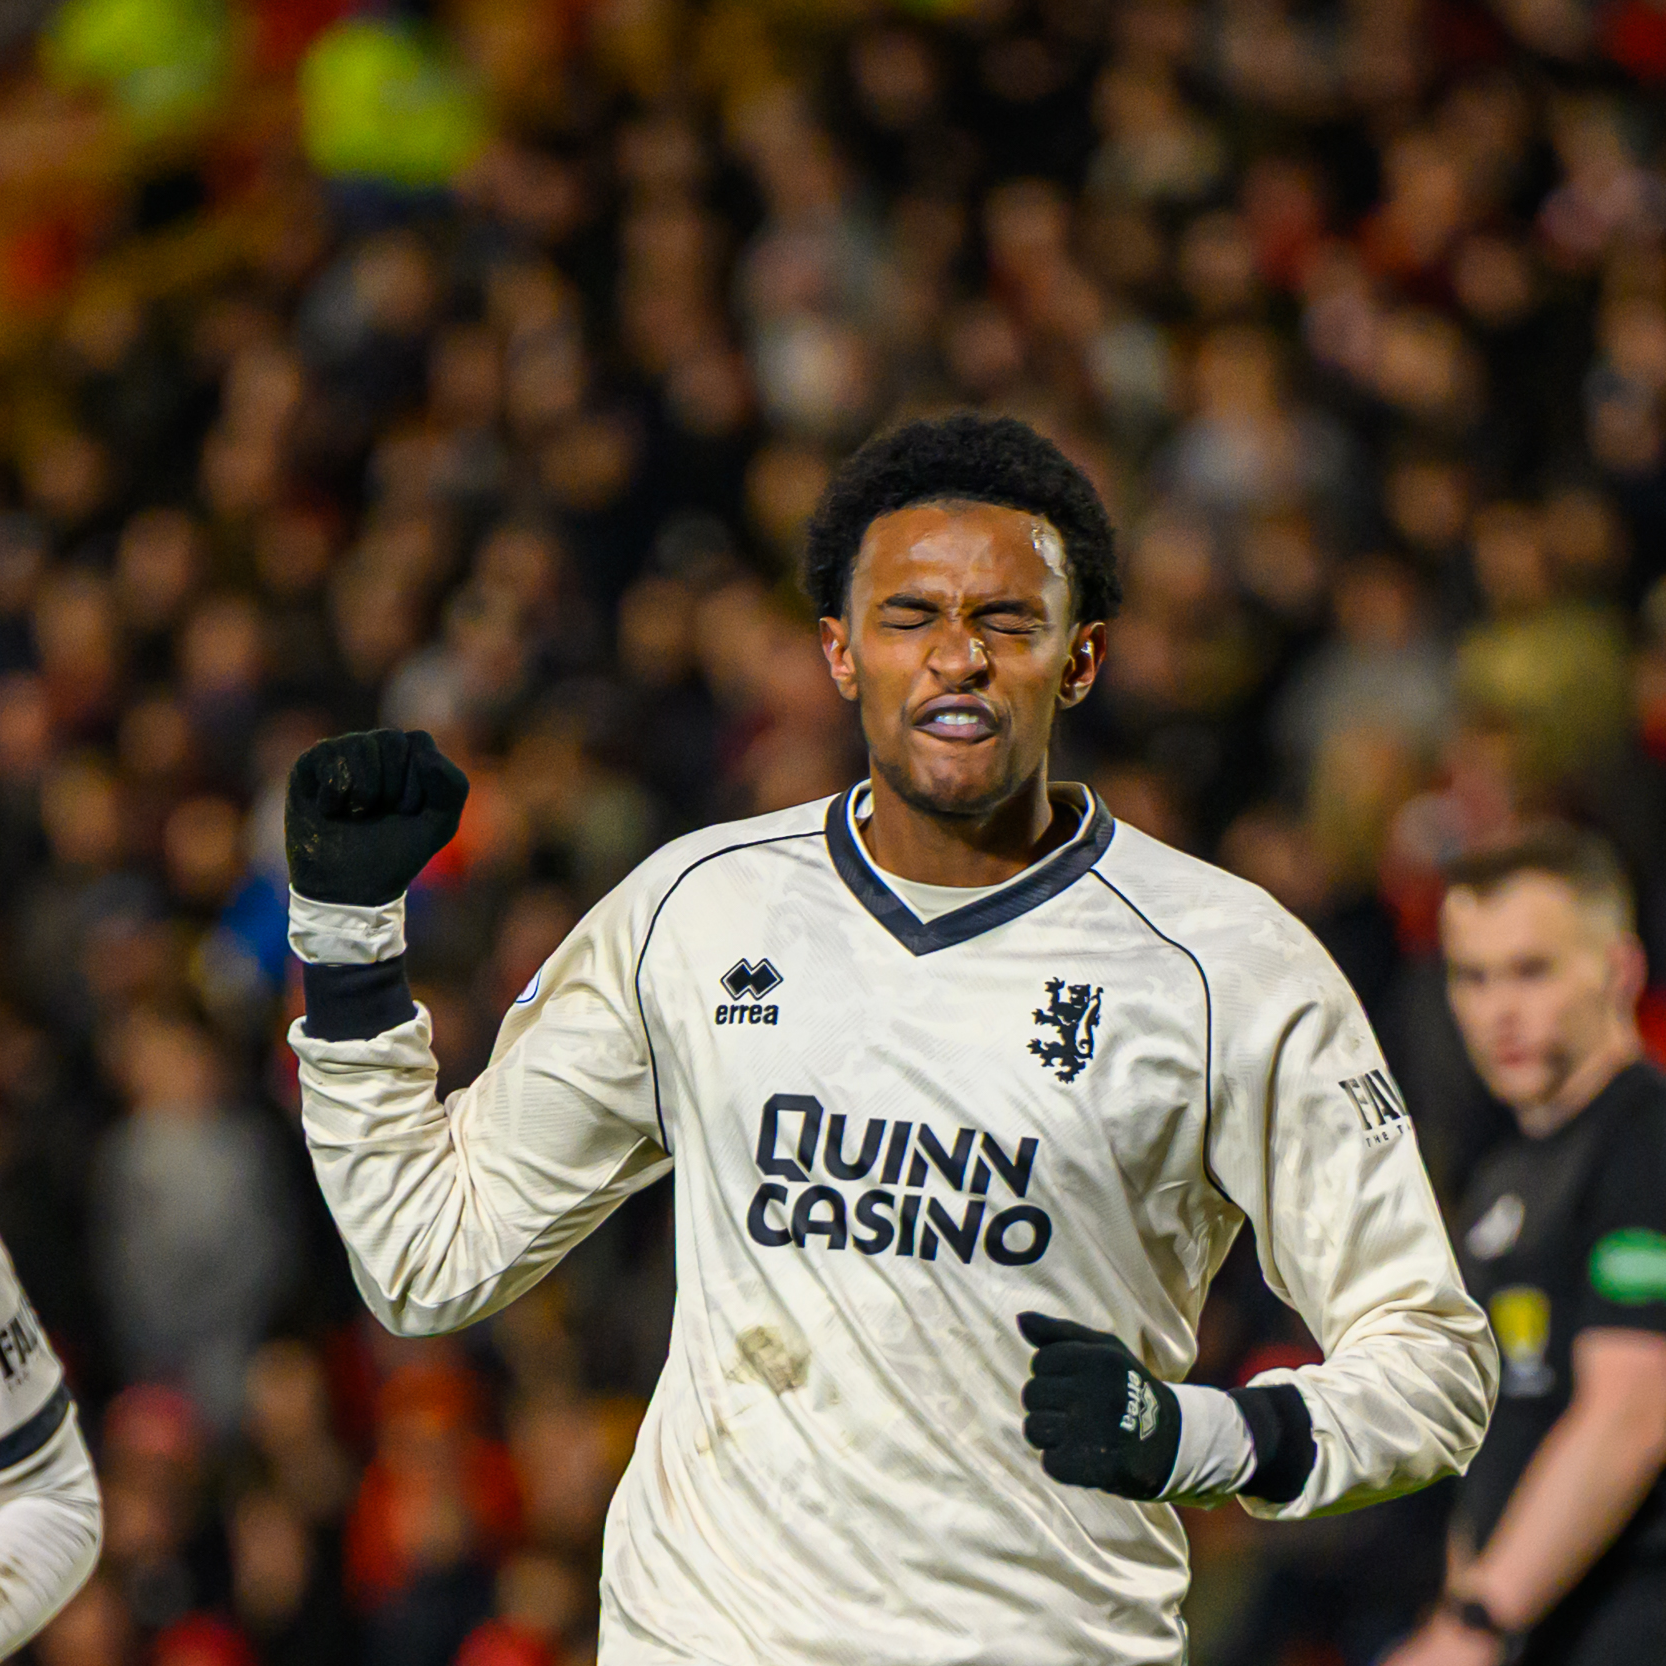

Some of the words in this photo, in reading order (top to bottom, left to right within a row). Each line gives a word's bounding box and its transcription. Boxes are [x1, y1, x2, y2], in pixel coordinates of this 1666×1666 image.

[715, 1004, 779, 1026] errea
[755, 1092, 1040, 1199] QUINN
[746, 1182, 1052, 1267] CASINO
